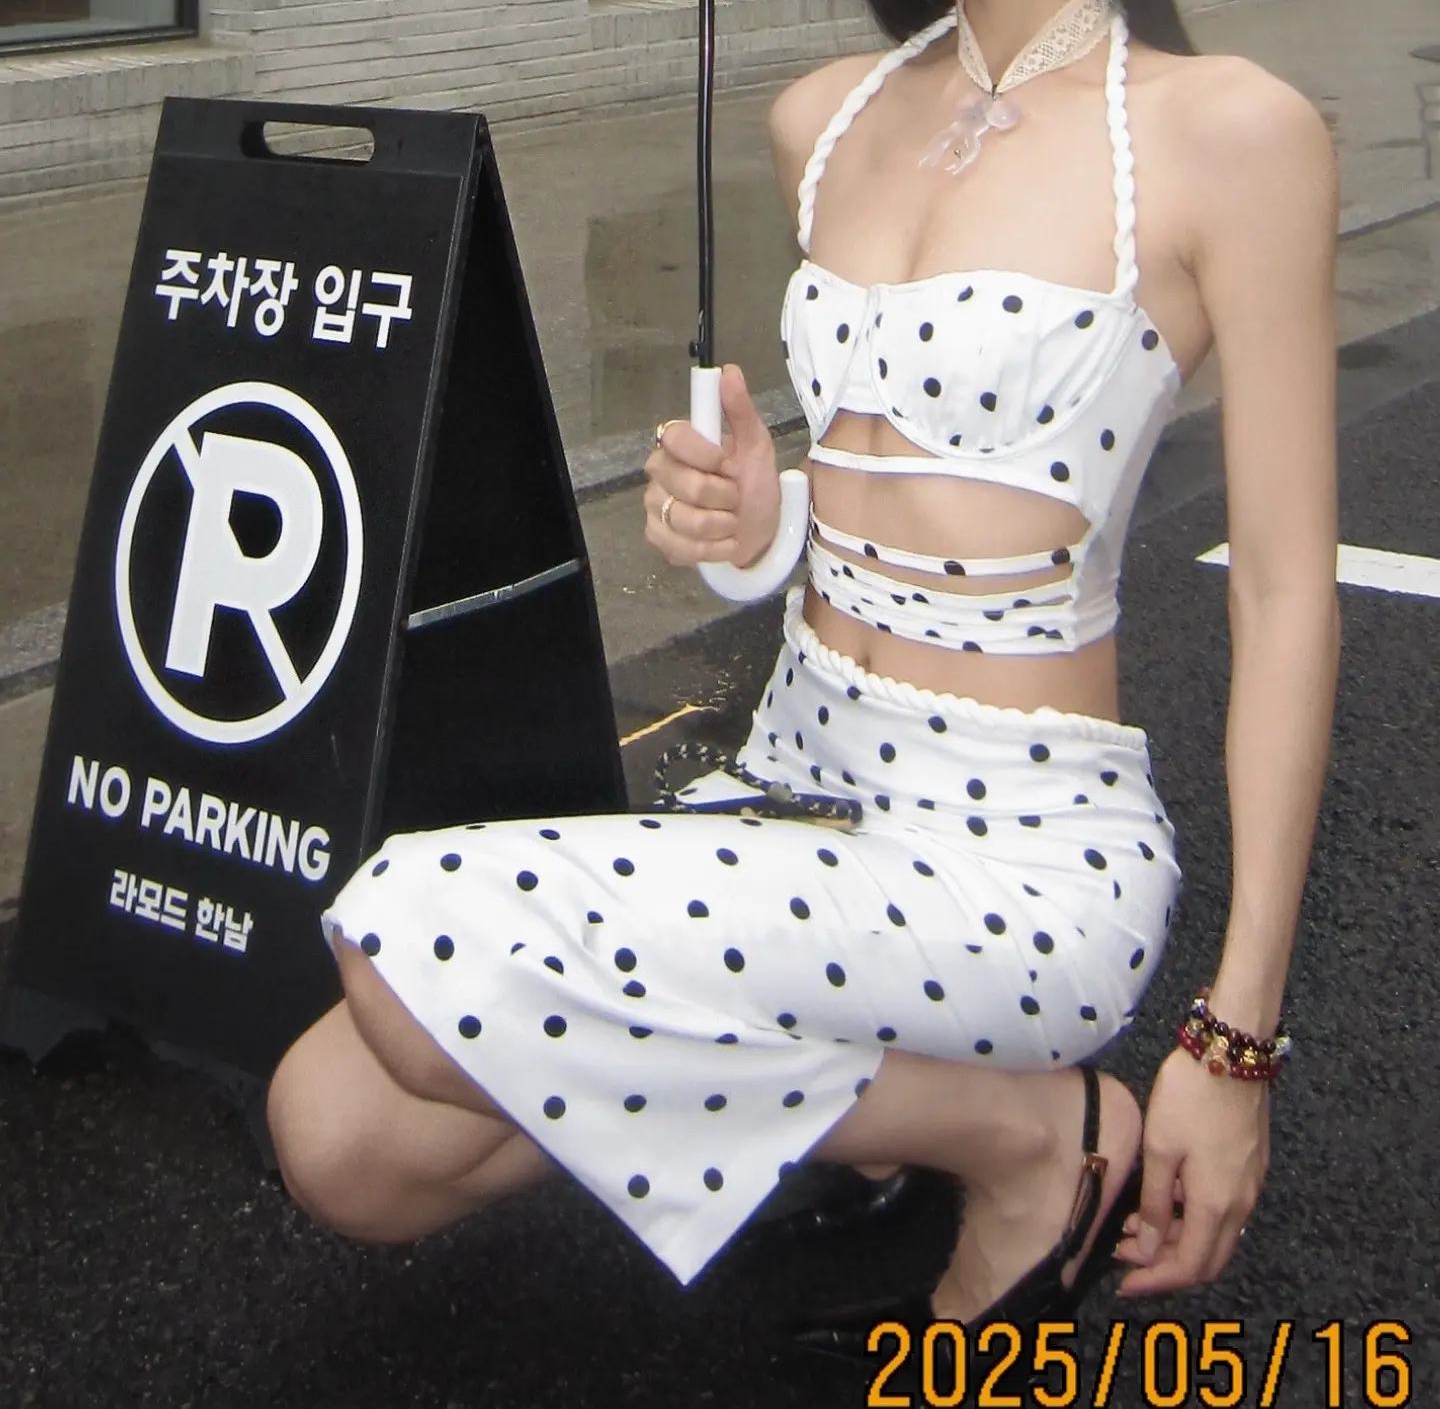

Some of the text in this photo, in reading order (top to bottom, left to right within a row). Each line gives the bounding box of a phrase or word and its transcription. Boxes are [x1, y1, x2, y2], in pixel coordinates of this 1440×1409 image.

[155, 249, 413, 349] 주차장 입구
[67, 755, 331, 881] NO PARKING
[109, 869, 254, 953] 라모드 한남
